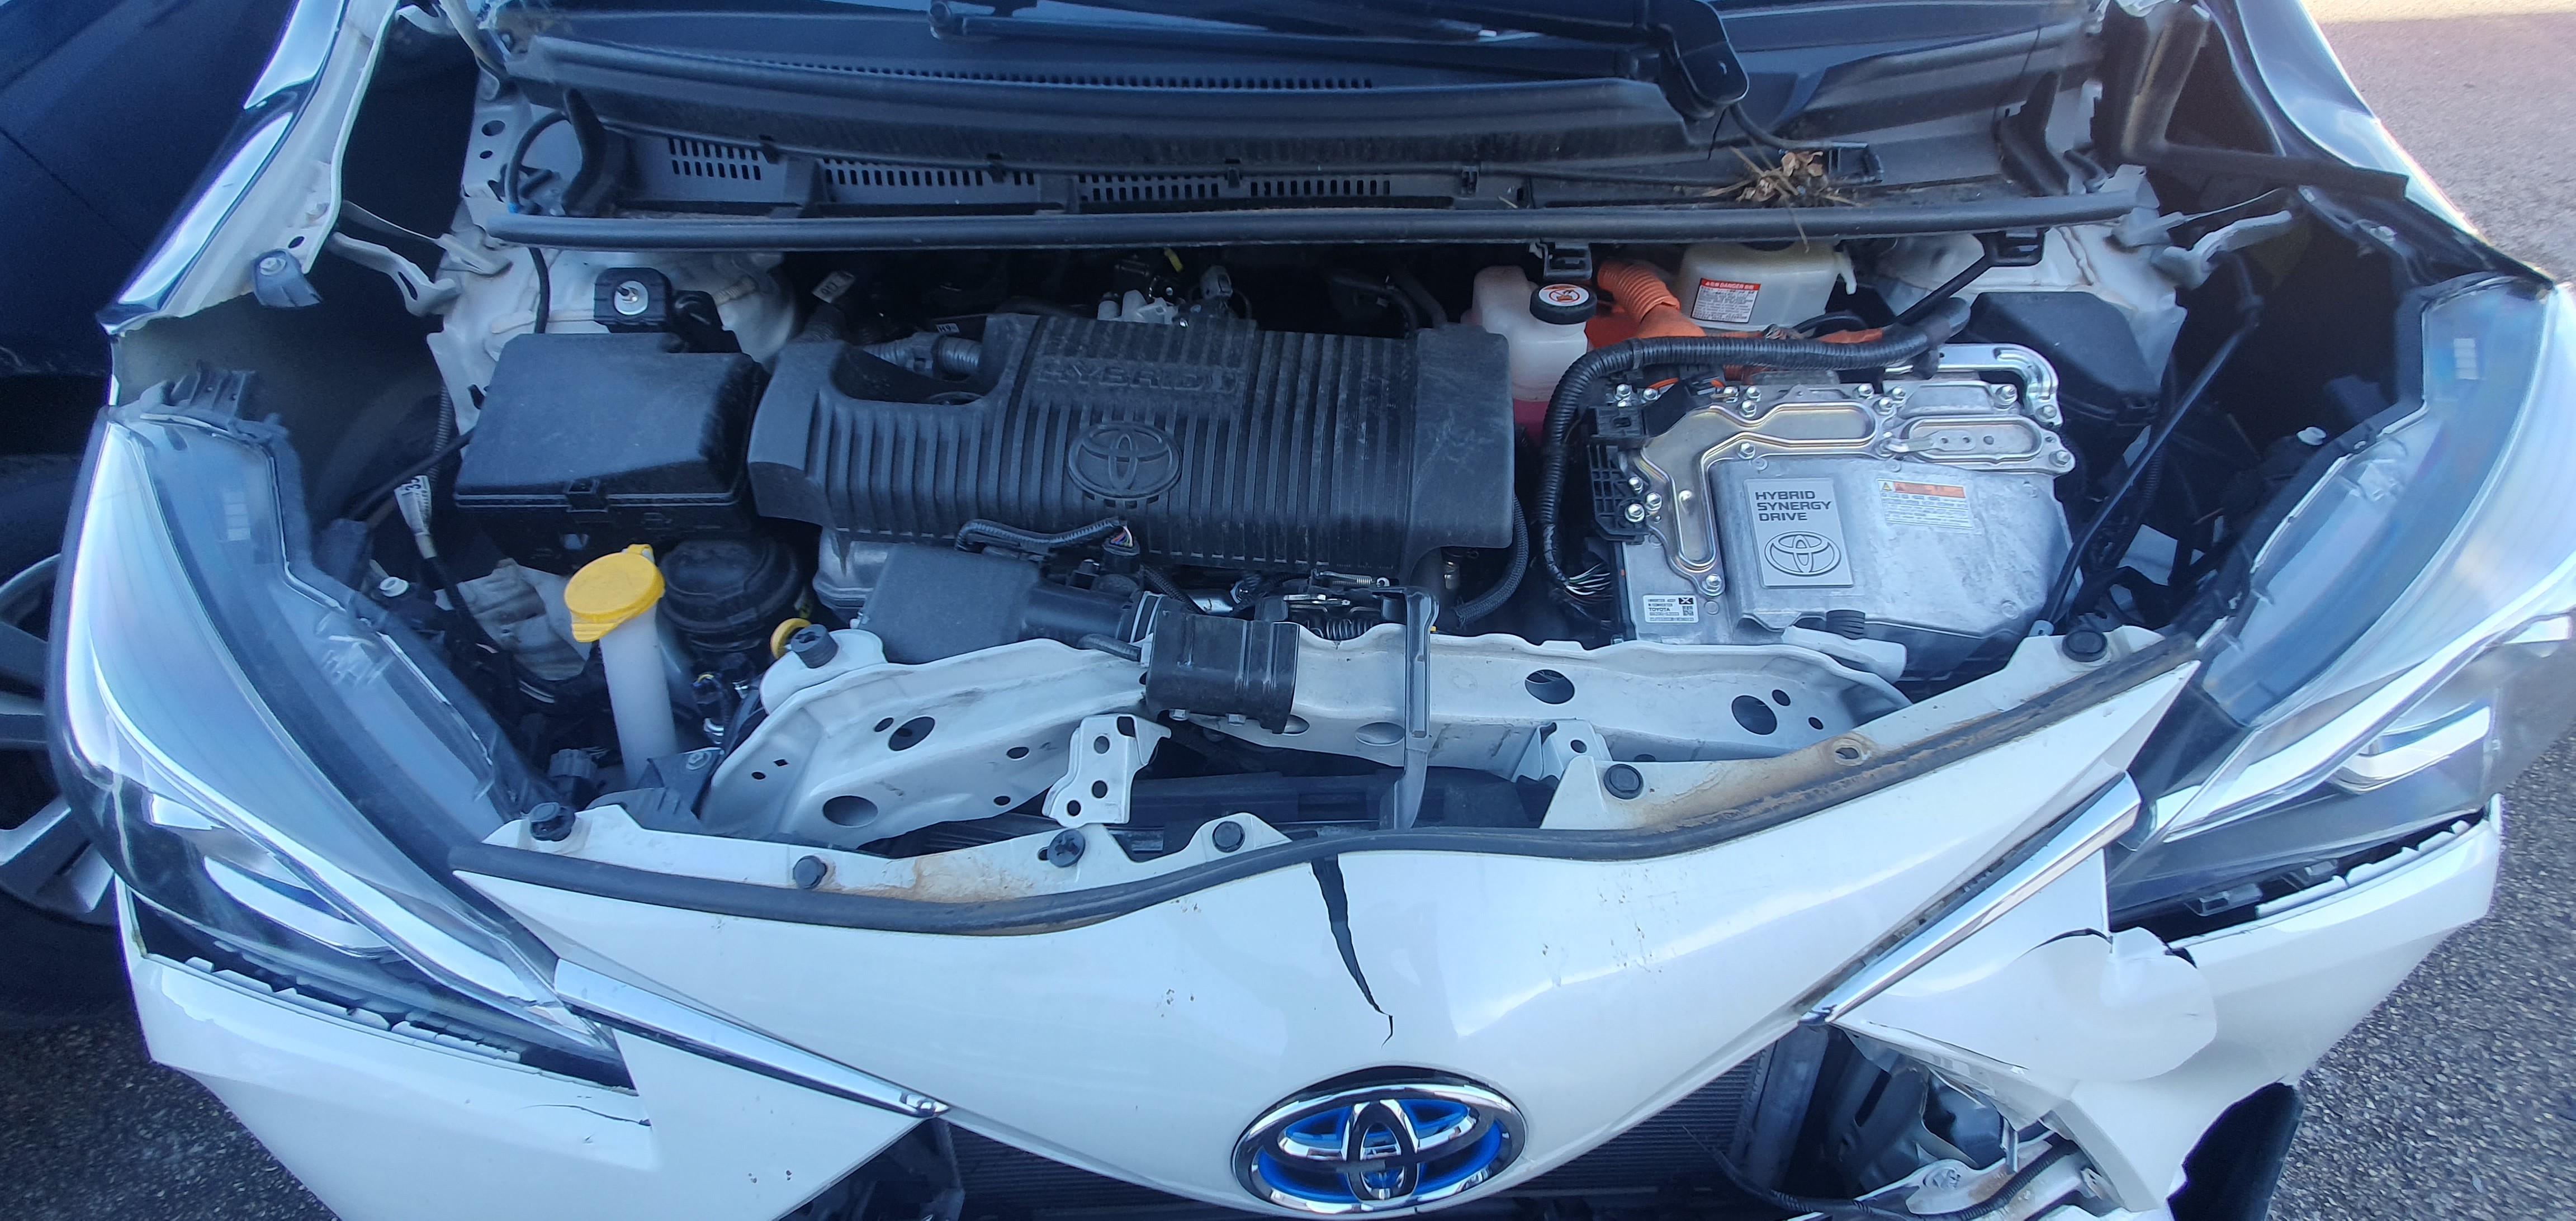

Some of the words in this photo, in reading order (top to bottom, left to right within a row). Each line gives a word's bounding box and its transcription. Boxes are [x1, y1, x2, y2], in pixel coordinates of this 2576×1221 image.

[1755, 491, 1816, 500] HYBRID
[1756, 501, 1832, 511] SYNERGY
[1759, 512, 1808, 521] DRIVE
